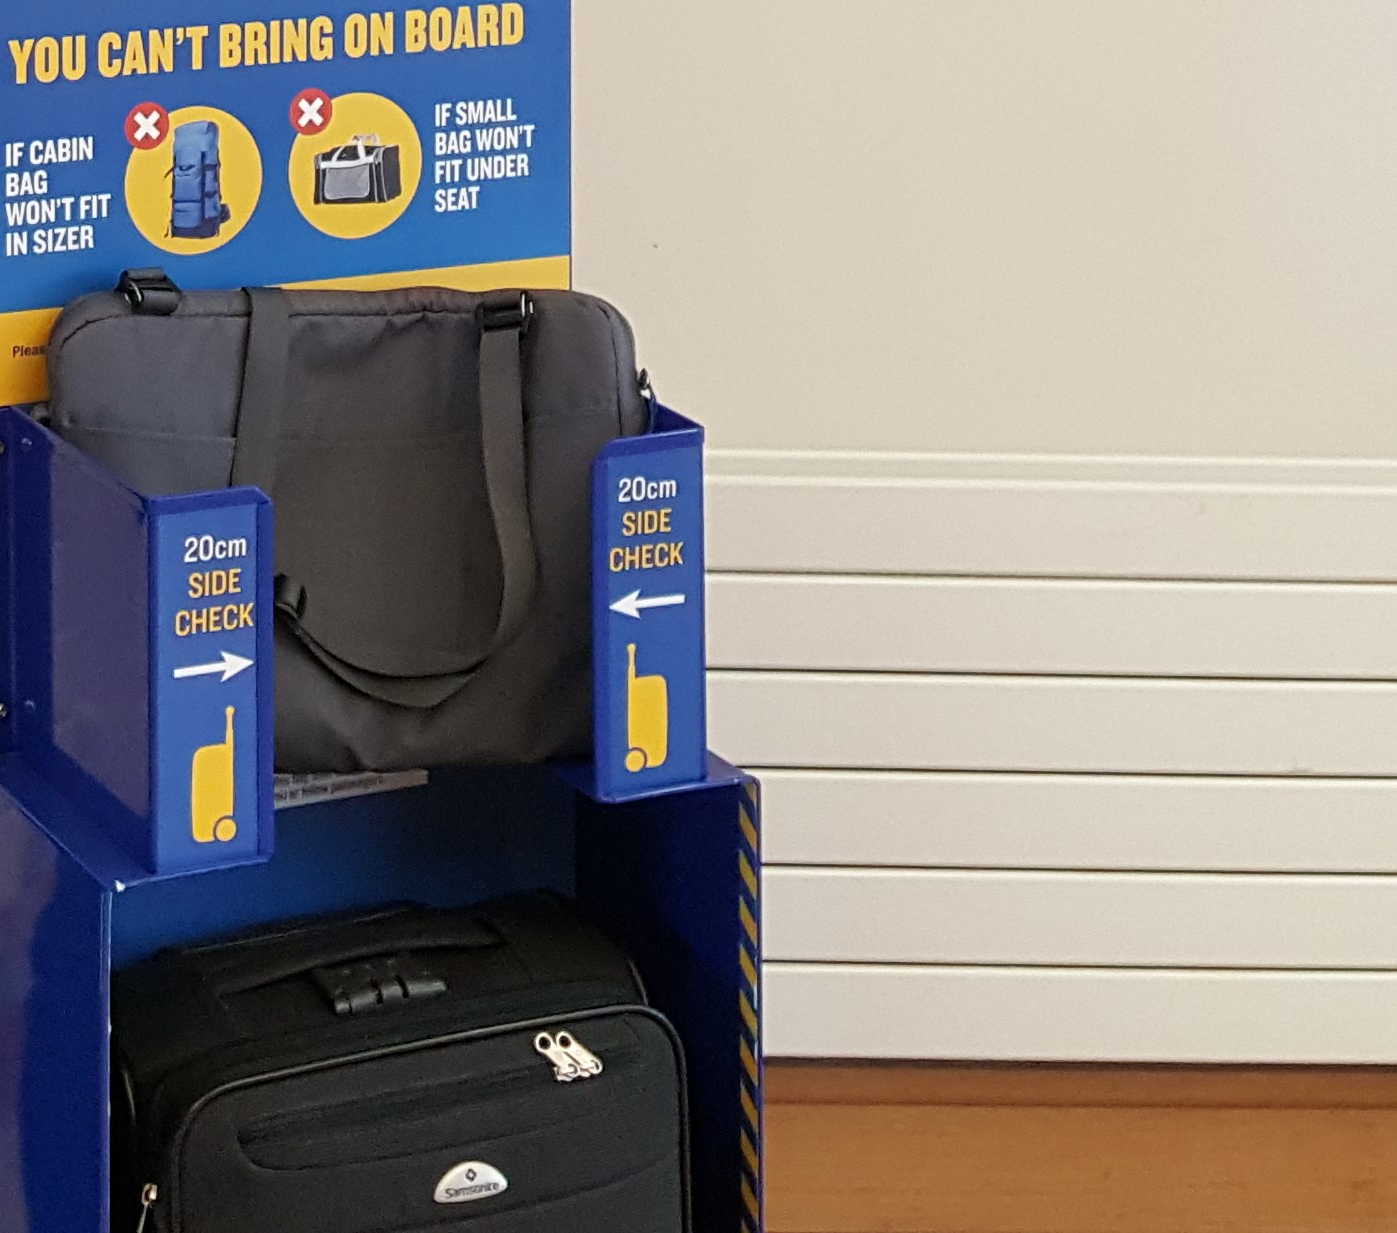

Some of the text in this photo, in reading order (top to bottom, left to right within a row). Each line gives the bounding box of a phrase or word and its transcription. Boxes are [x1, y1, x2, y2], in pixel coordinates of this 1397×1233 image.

[9, 2, 524, 86] YOU CAN'T BRING ON BOARD
[435, 98, 516, 128] IF SMALL
[5, 136, 94, 166] IF CABIN
[435, 124, 535, 156] BAG WON'T
[6, 170, 48, 197] BAG
[435, 154, 529, 184] FIT UNDER
[5, 193, 110, 227] WON'T FIT
[434, 186, 480, 213] SEAT
[6, 228, 94, 257] IN SIZER
[617, 476, 677, 503] 20cm
[622, 508, 672, 536] SIDE
[183, 535, 247, 564] 20cm
[609, 541, 684, 572] CHECK
[188, 568, 241, 598] SIDE
[175, 602, 254, 637] CHECK
